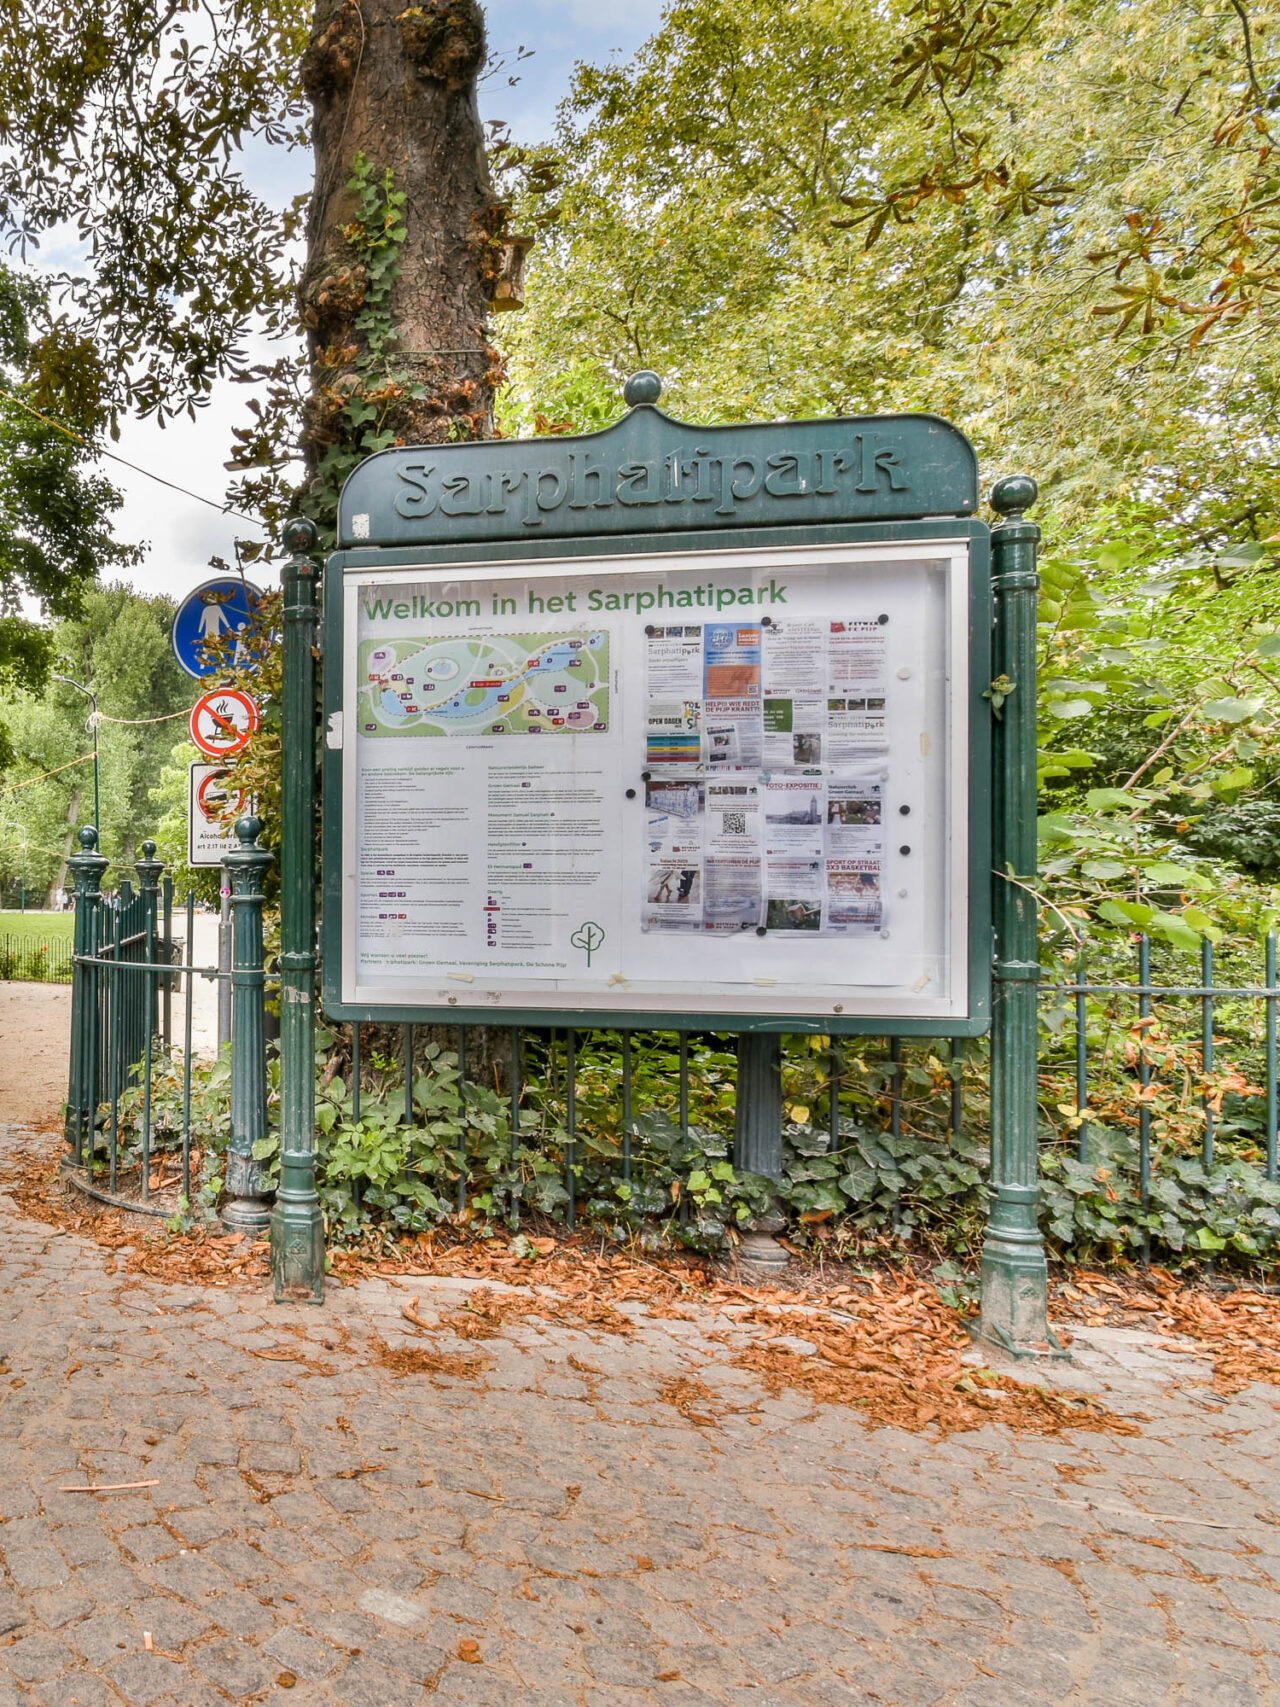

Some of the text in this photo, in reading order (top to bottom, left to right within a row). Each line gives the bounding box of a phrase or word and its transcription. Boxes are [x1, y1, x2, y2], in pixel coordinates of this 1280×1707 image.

[394, 431, 912, 526] Sarphatipark
[364, 580, 788, 621] Welkom in het Sarphatipark
